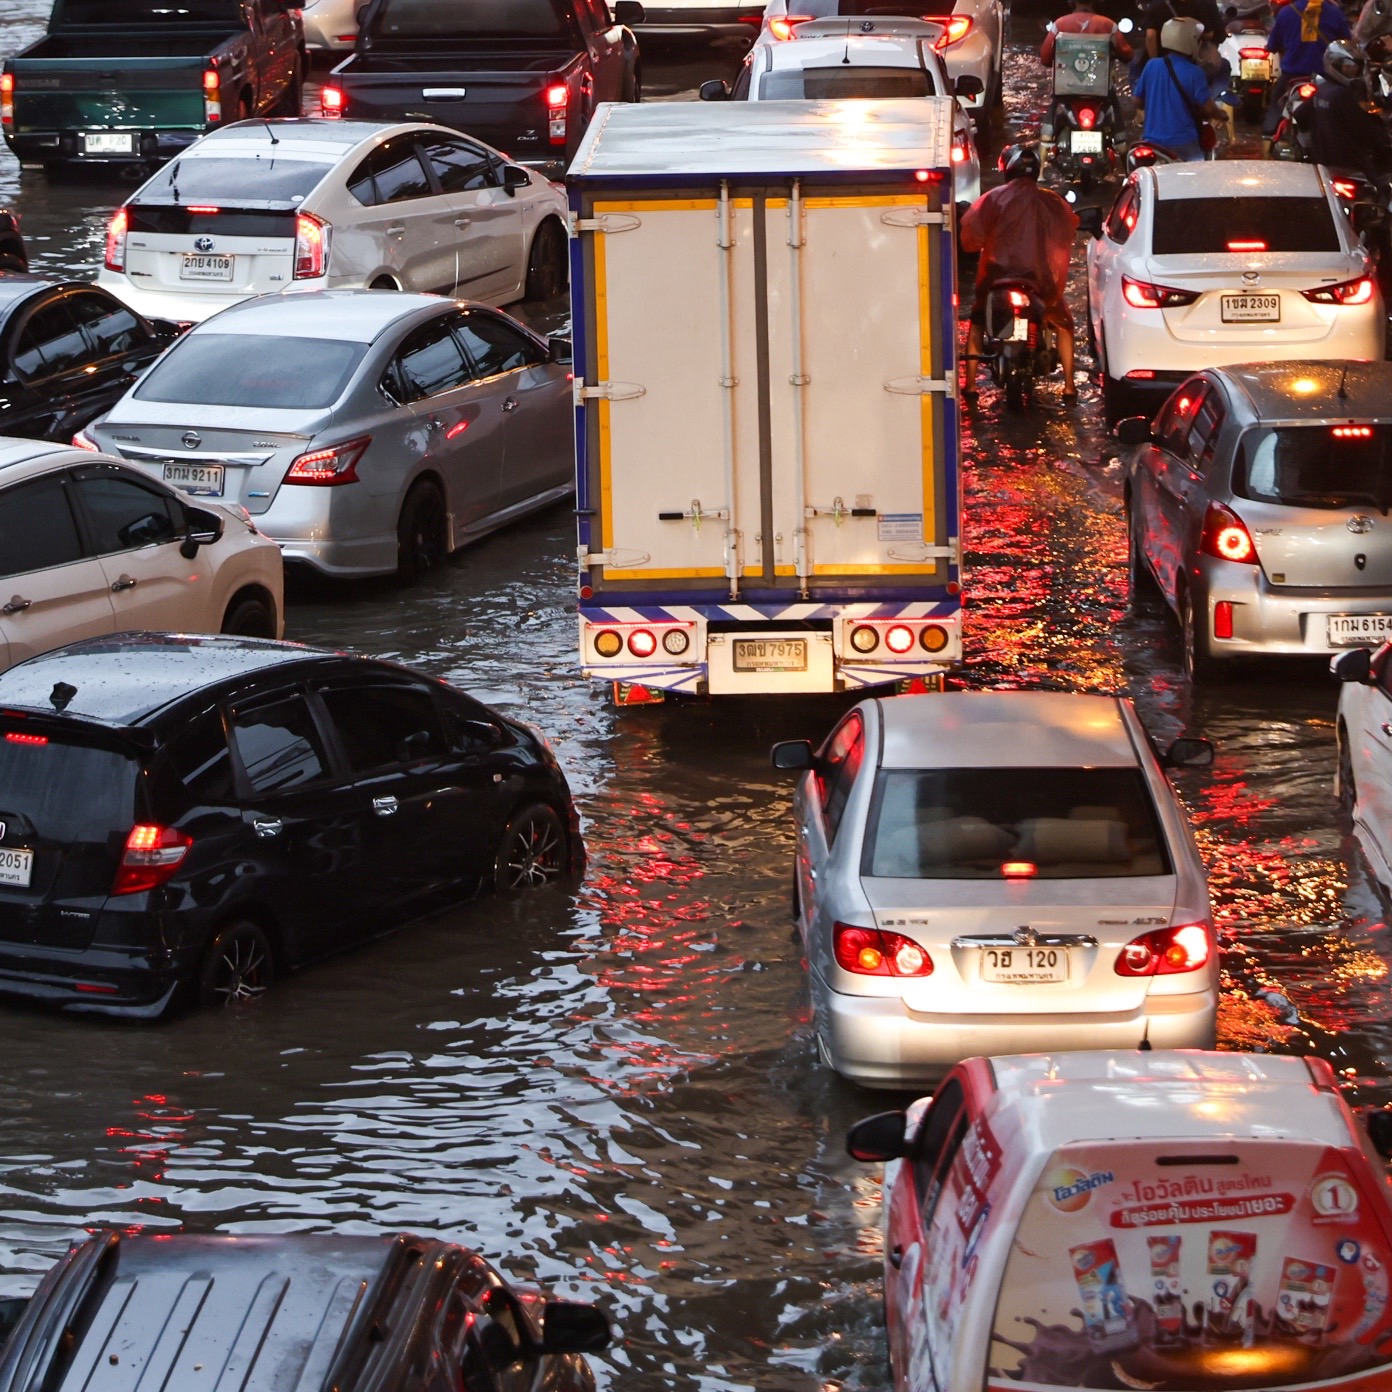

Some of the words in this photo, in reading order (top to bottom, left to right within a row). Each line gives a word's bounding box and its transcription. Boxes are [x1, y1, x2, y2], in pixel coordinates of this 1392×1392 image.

[206, 258, 230, 269] 4109
[1250, 298, 1277, 309] 2309
[166, 467, 190, 482] 3กม
[191, 468, 219, 482] 9211
[1334, 618, 1359, 631] 1กม
[1362, 618, 1392, 631] 6154
[769, 643, 803, 657] 7975
[1027, 950, 1057, 968] 120
[996, 972, 1053, 980] กรุงเทพมหานคร
[1327, 1185, 1341, 1209] 1
